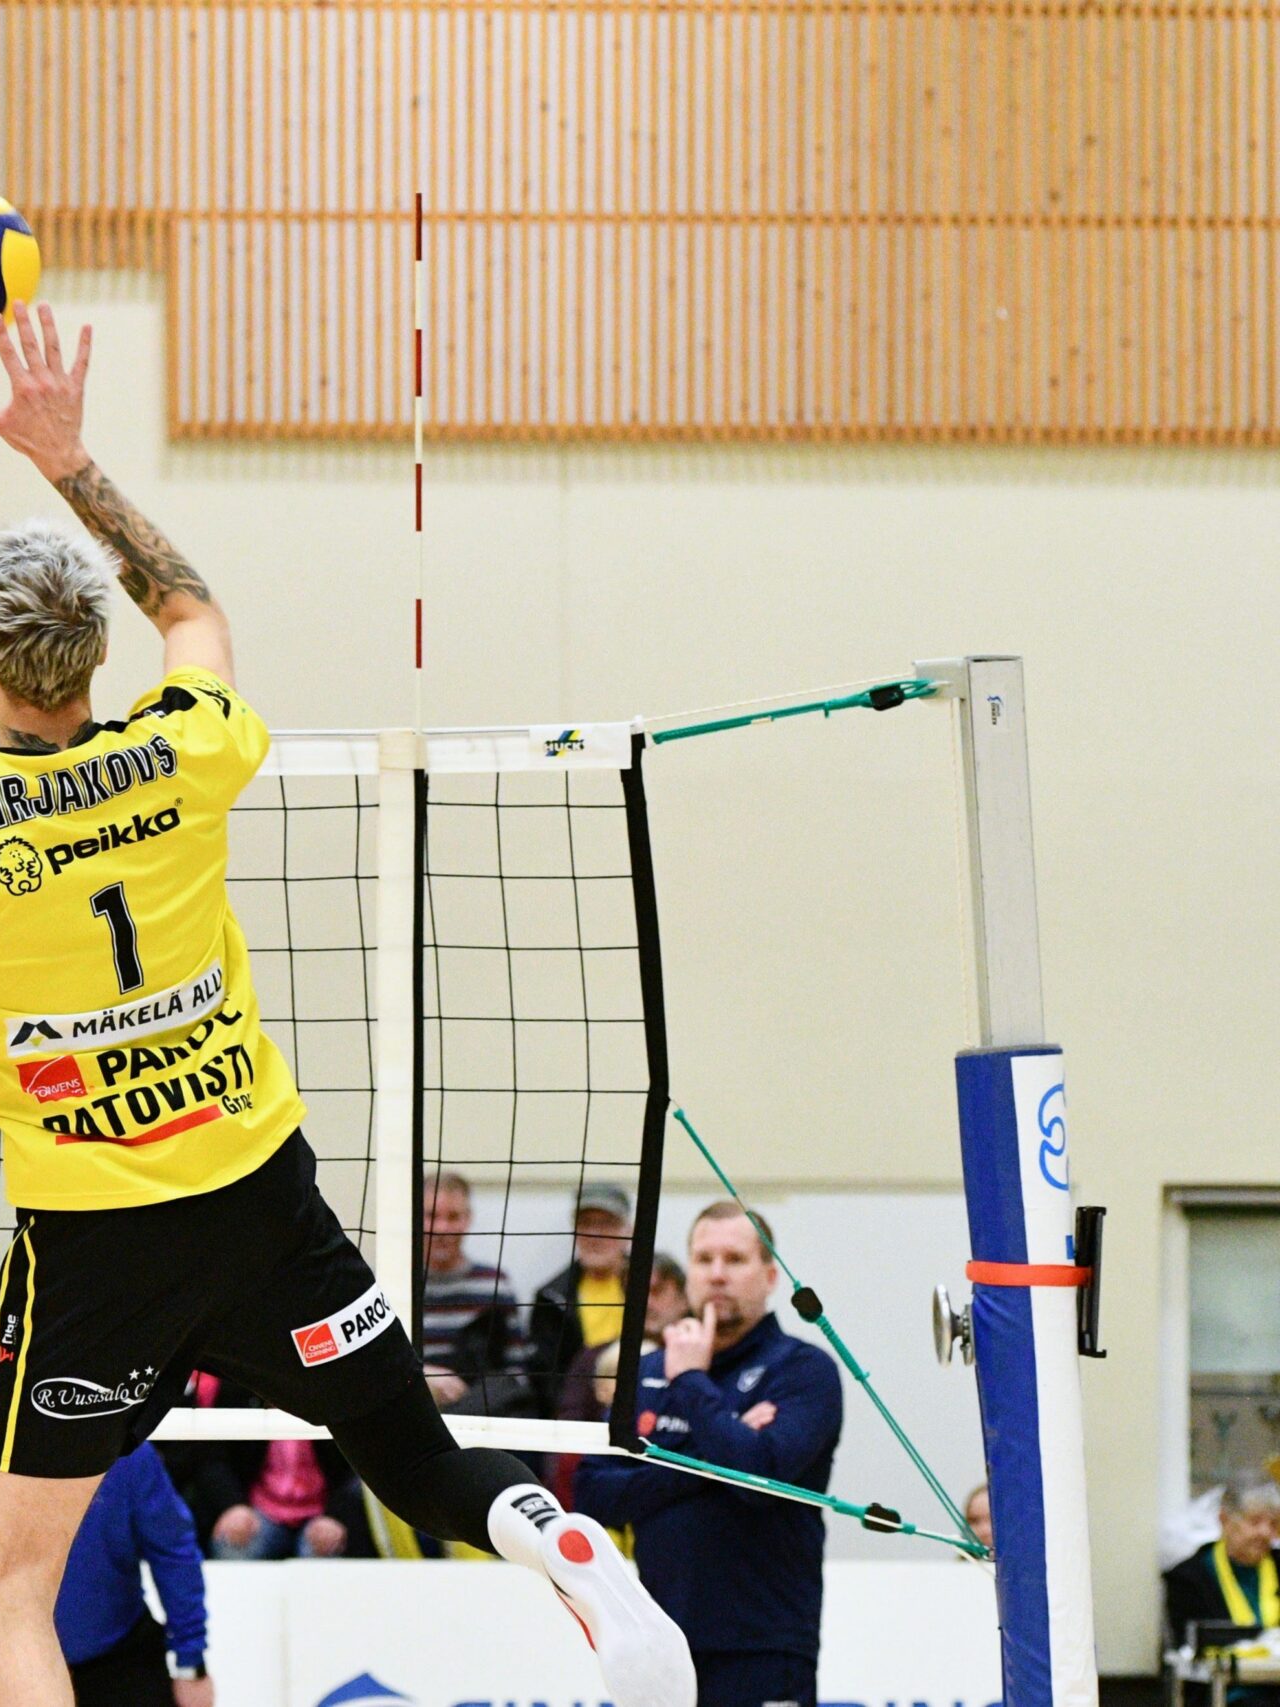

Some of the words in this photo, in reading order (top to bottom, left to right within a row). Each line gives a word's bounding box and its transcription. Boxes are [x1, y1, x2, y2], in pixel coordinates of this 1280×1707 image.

[44, 807, 181, 875] peikko
[90, 881, 144, 995] 1
[72, 989, 184, 1038] MÄKELÄ
[58, 1382, 130, 1406] Uusisalo
